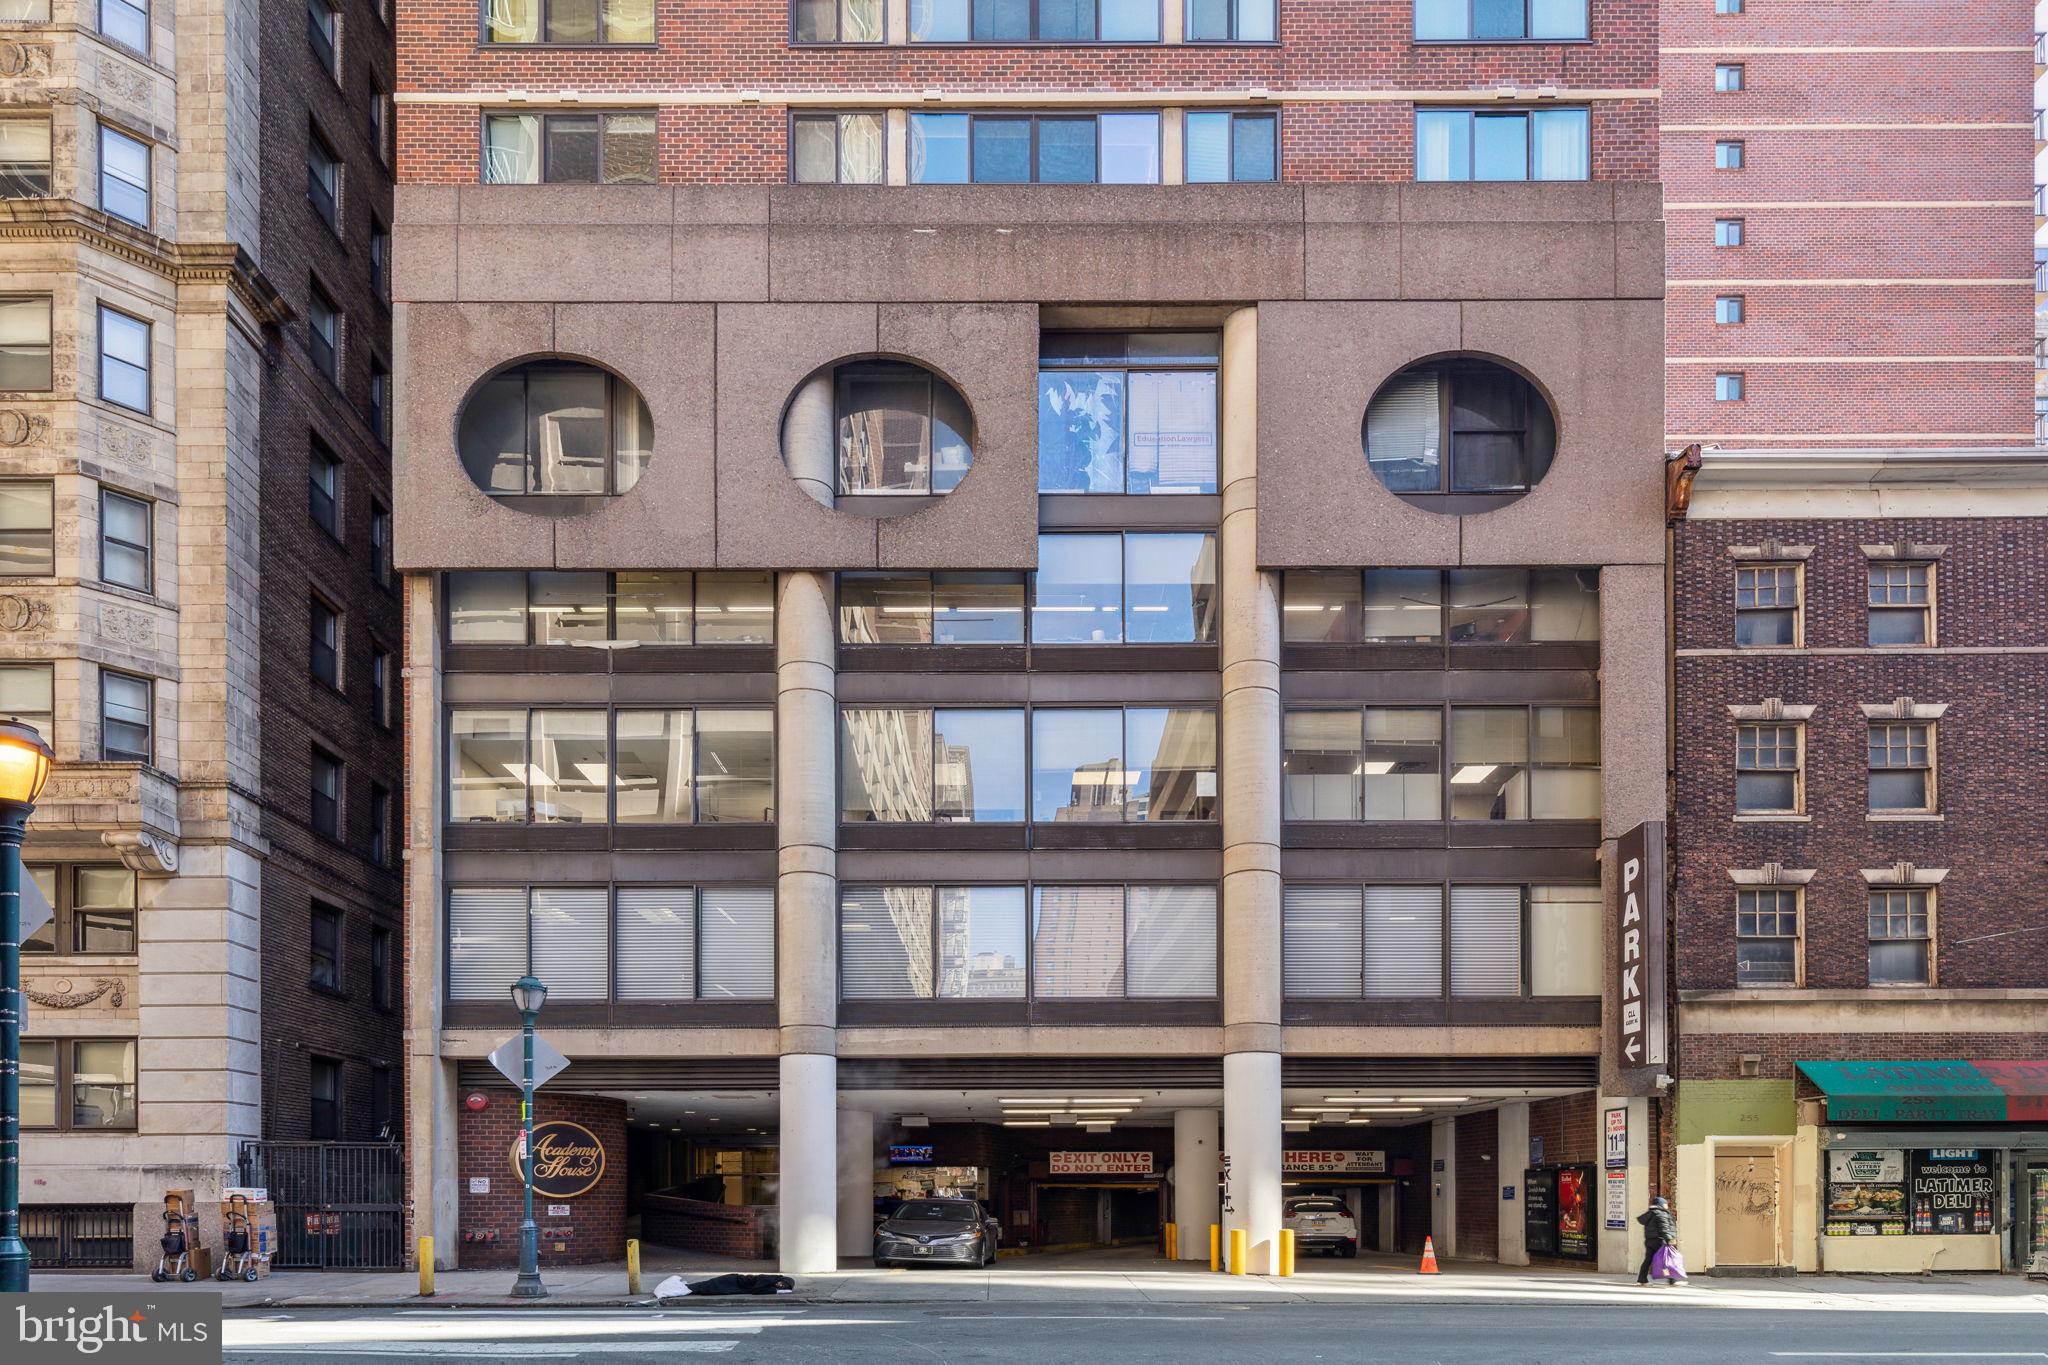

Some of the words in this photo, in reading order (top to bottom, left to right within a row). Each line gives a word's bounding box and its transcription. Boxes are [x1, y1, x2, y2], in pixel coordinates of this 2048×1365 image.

[1622, 857, 1641, 1000] PARK
[1902, 1096, 1937, 1105] 255
[1740, 1114, 1760, 1122] 255
[1838, 1109, 1880, 1121] DELI
[1897, 1109, 1950, 1121] PARTY
[532, 1133, 601, 1166] Academy
[1932, 1149, 1976, 1158] LIGHT
[1063, 1153, 1097, 1164] EXIT
[1101, 1153, 1140, 1164] ONLY
[1284, 1151, 1332, 1163] HERE
[533, 1156, 597, 1179] House
[1051, 1164, 1071, 1173] DO
[1074, 1164, 1102, 1173] NOT
[1106, 1164, 1151, 1173] ENTER
[1920, 1164, 1971, 1174] welcome
[1973, 1164, 1988, 1174] to
[1915, 1178, 1993, 1193] LATIMER
[1933, 1193, 1972, 1209] DELI
